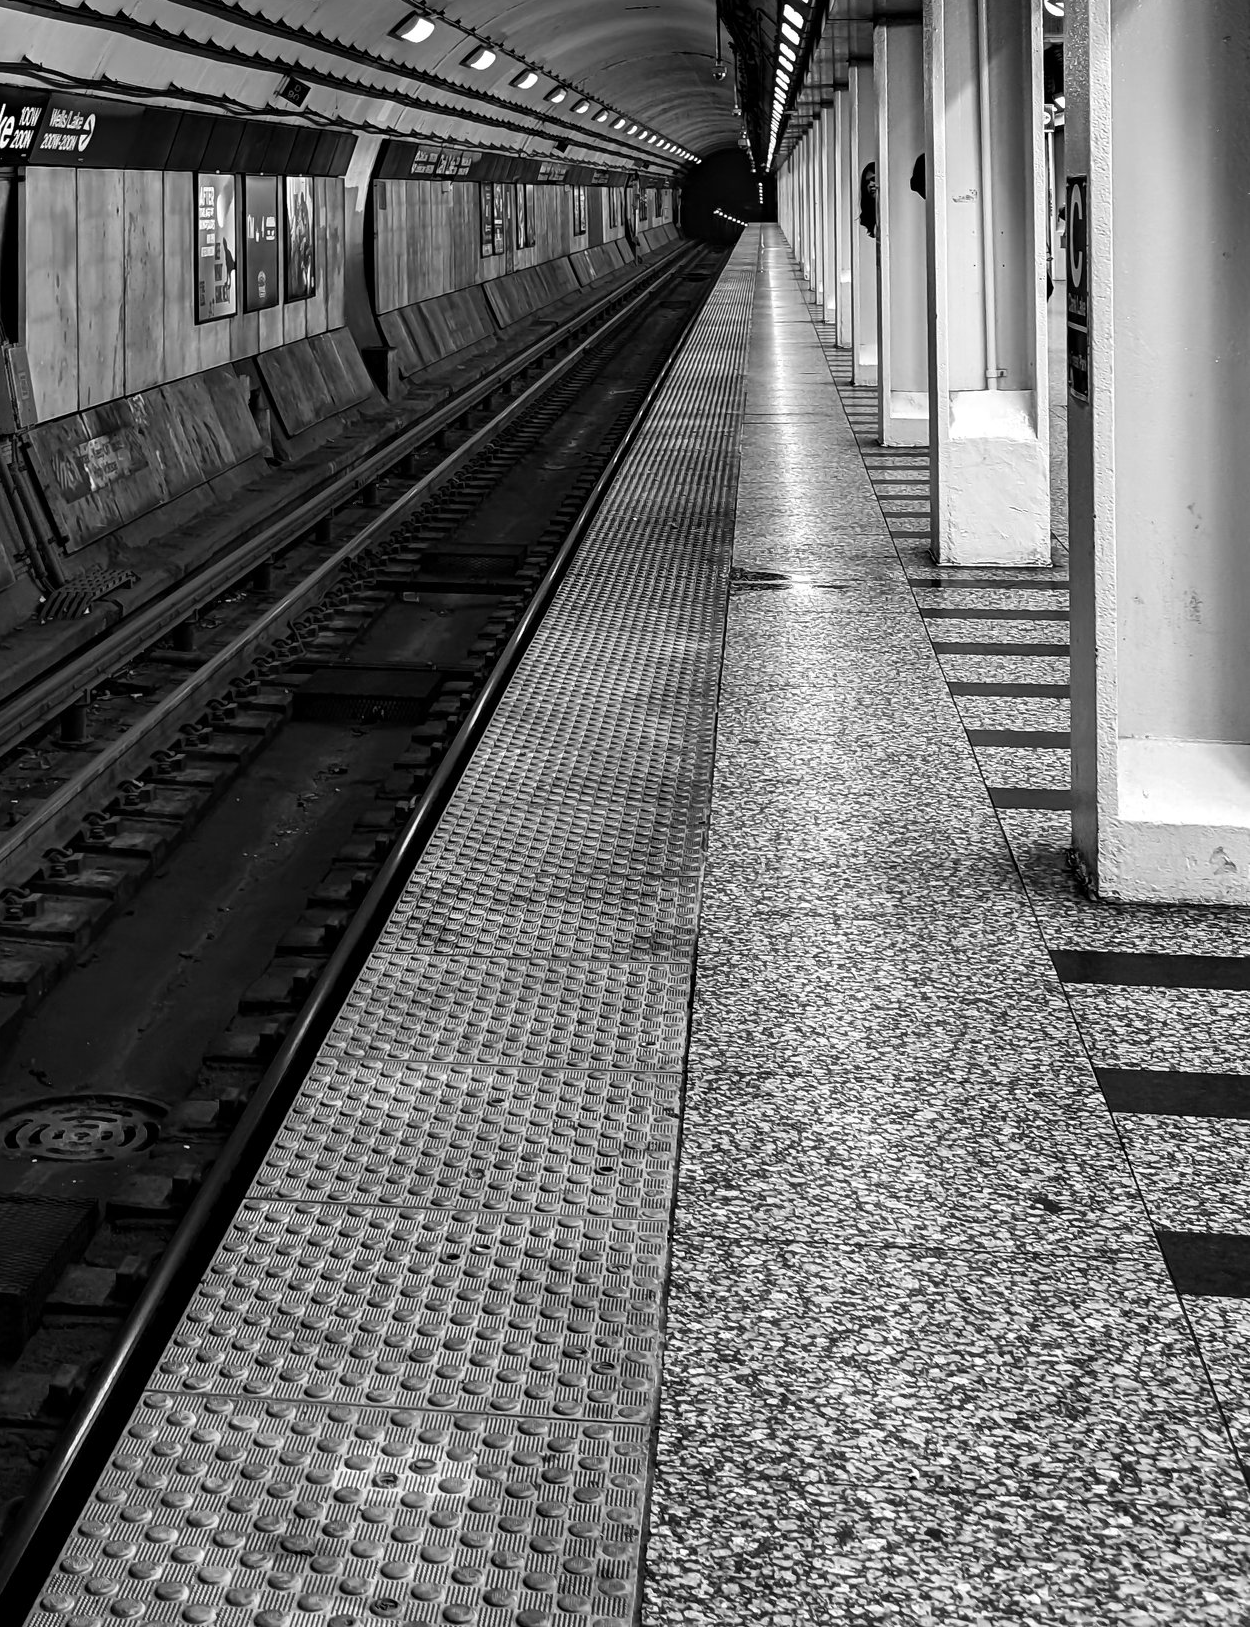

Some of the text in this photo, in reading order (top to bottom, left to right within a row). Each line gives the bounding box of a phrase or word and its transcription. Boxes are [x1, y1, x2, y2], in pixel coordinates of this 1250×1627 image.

[19, 107, 42, 127] 100W
[49, 108, 84, 129] Wells/Lake
[10, 130, 34, 149] 200N
